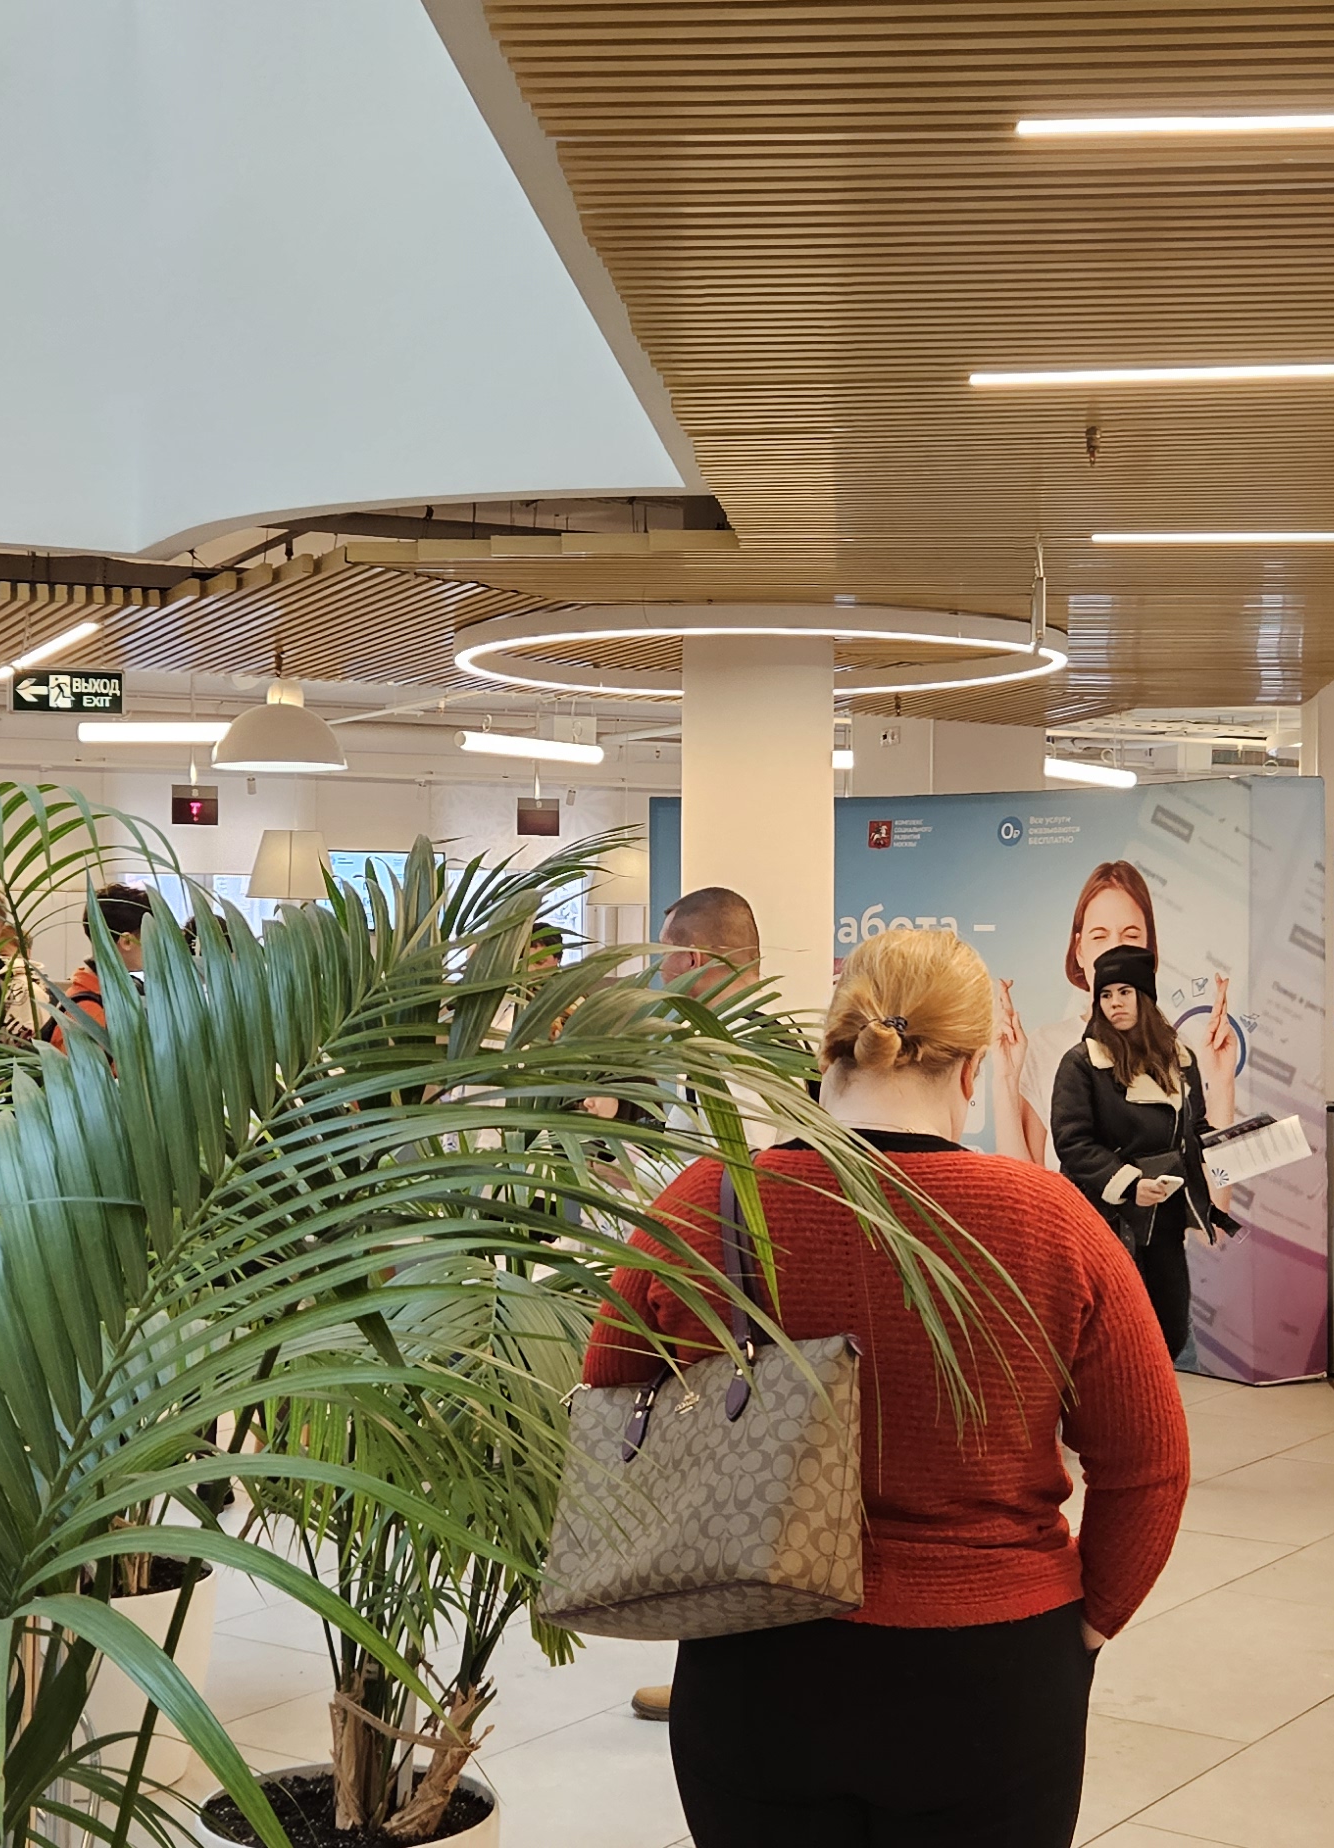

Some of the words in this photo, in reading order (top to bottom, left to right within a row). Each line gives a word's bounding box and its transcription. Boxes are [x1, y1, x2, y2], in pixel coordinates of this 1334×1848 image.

[73, 678, 120, 696] ВЫХОД
[82, 696, 112, 707] EXIT
[1028, 835, 1074, 845] БЕСПЛАТНО
[834, 903, 958, 943] абота
